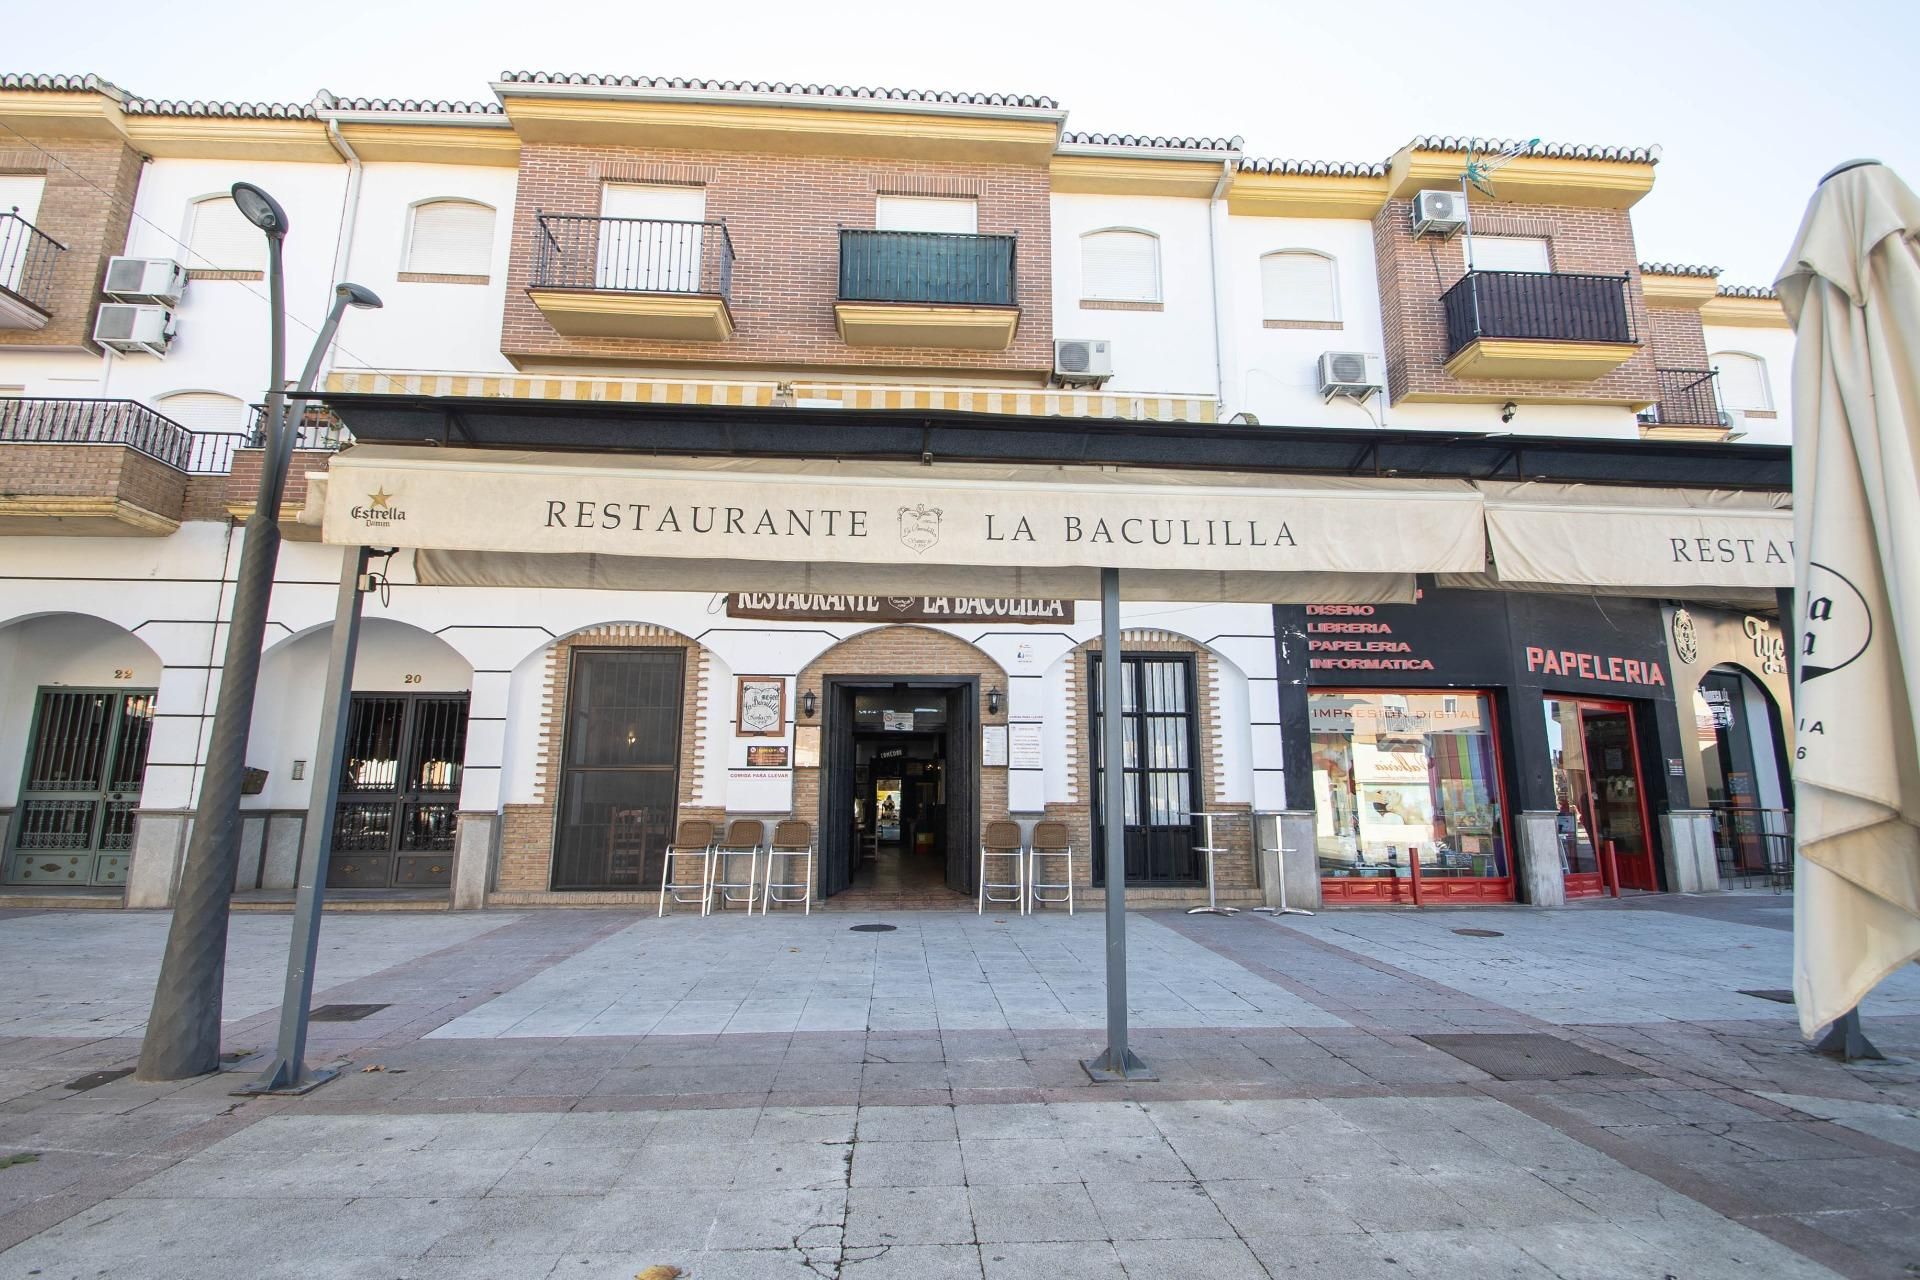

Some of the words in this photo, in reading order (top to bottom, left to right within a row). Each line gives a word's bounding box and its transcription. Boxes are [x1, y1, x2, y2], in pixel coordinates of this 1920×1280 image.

[351, 505, 406, 520] Estrella
[545, 500, 868, 537] RESTAURANTE
[985, 514, 1036, 542] LA
[1064, 516, 1298, 547] BACULILLA
[1670, 538, 1794, 564] RESTA
[1307, 622, 1392, 634] LIBRERIA
[1308, 640, 1412, 652] PAPELERIA
[1310, 658, 1435, 670] INFORMATICA
[1526, 646, 1666, 687] PAPELERIA
[114, 669, 133, 679] 22
[404, 674, 422, 684] 20
